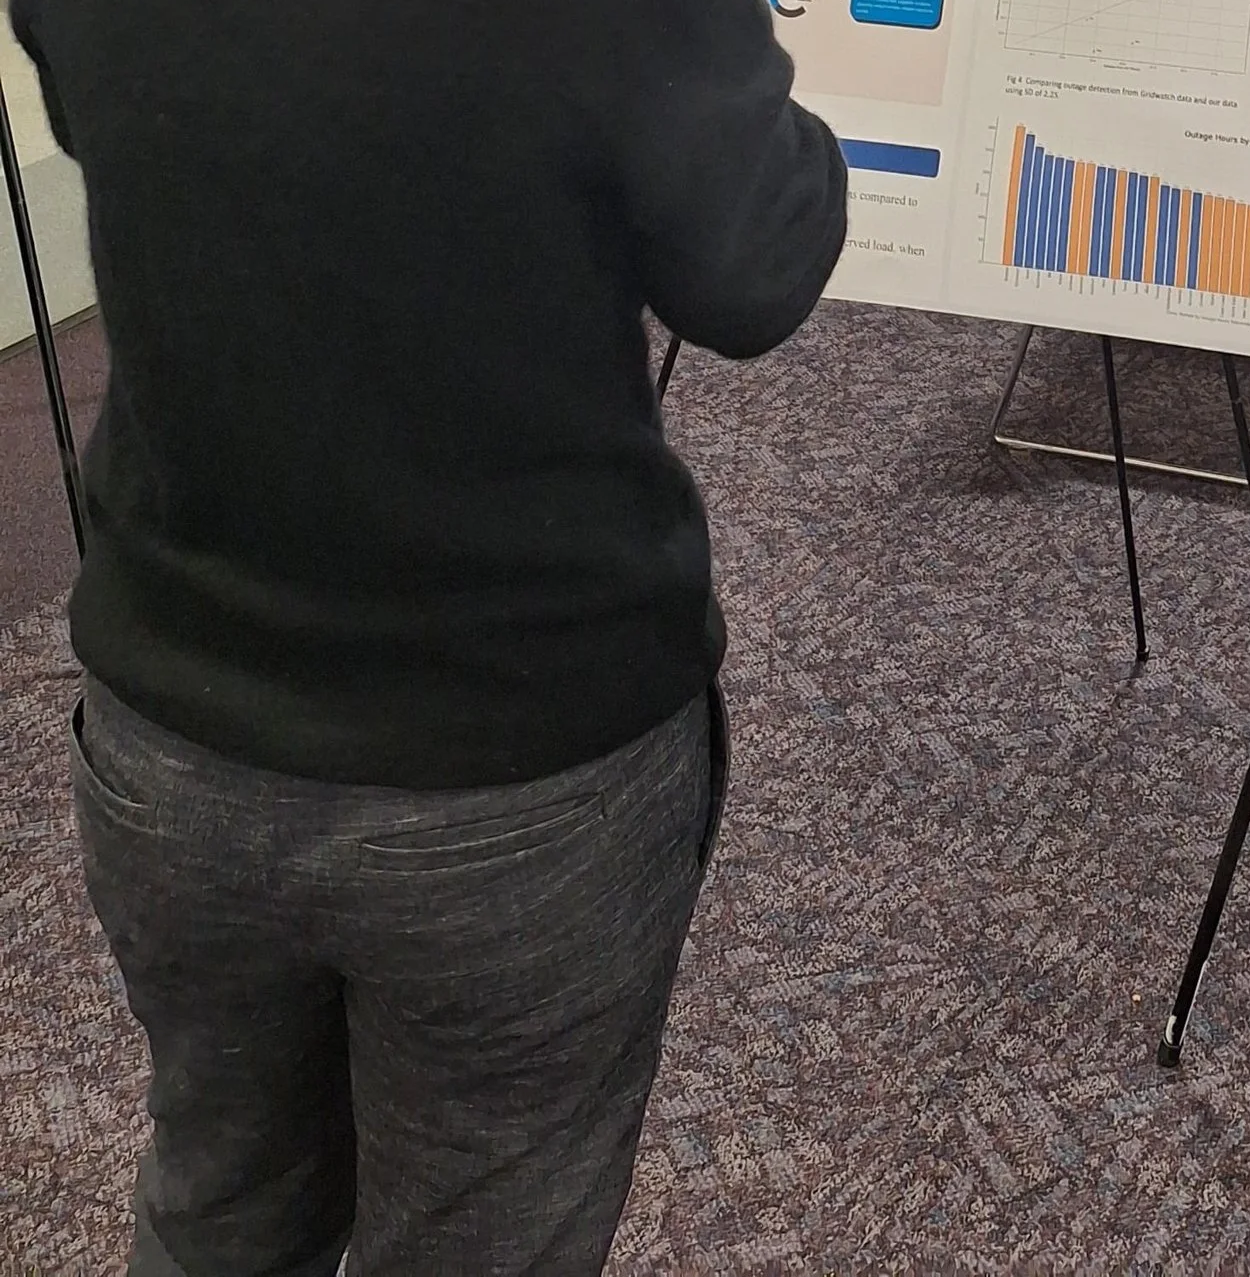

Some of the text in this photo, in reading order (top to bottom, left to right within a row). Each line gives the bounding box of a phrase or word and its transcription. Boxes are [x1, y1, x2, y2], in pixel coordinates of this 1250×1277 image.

[1184, 130, 1212, 141] Outage
[1215, 134, 1238, 143] Hours
[1240, 137, 1250, 145] by
[860, 193, 917, 206] compared to
[873, 240, 924, 256] load, when
